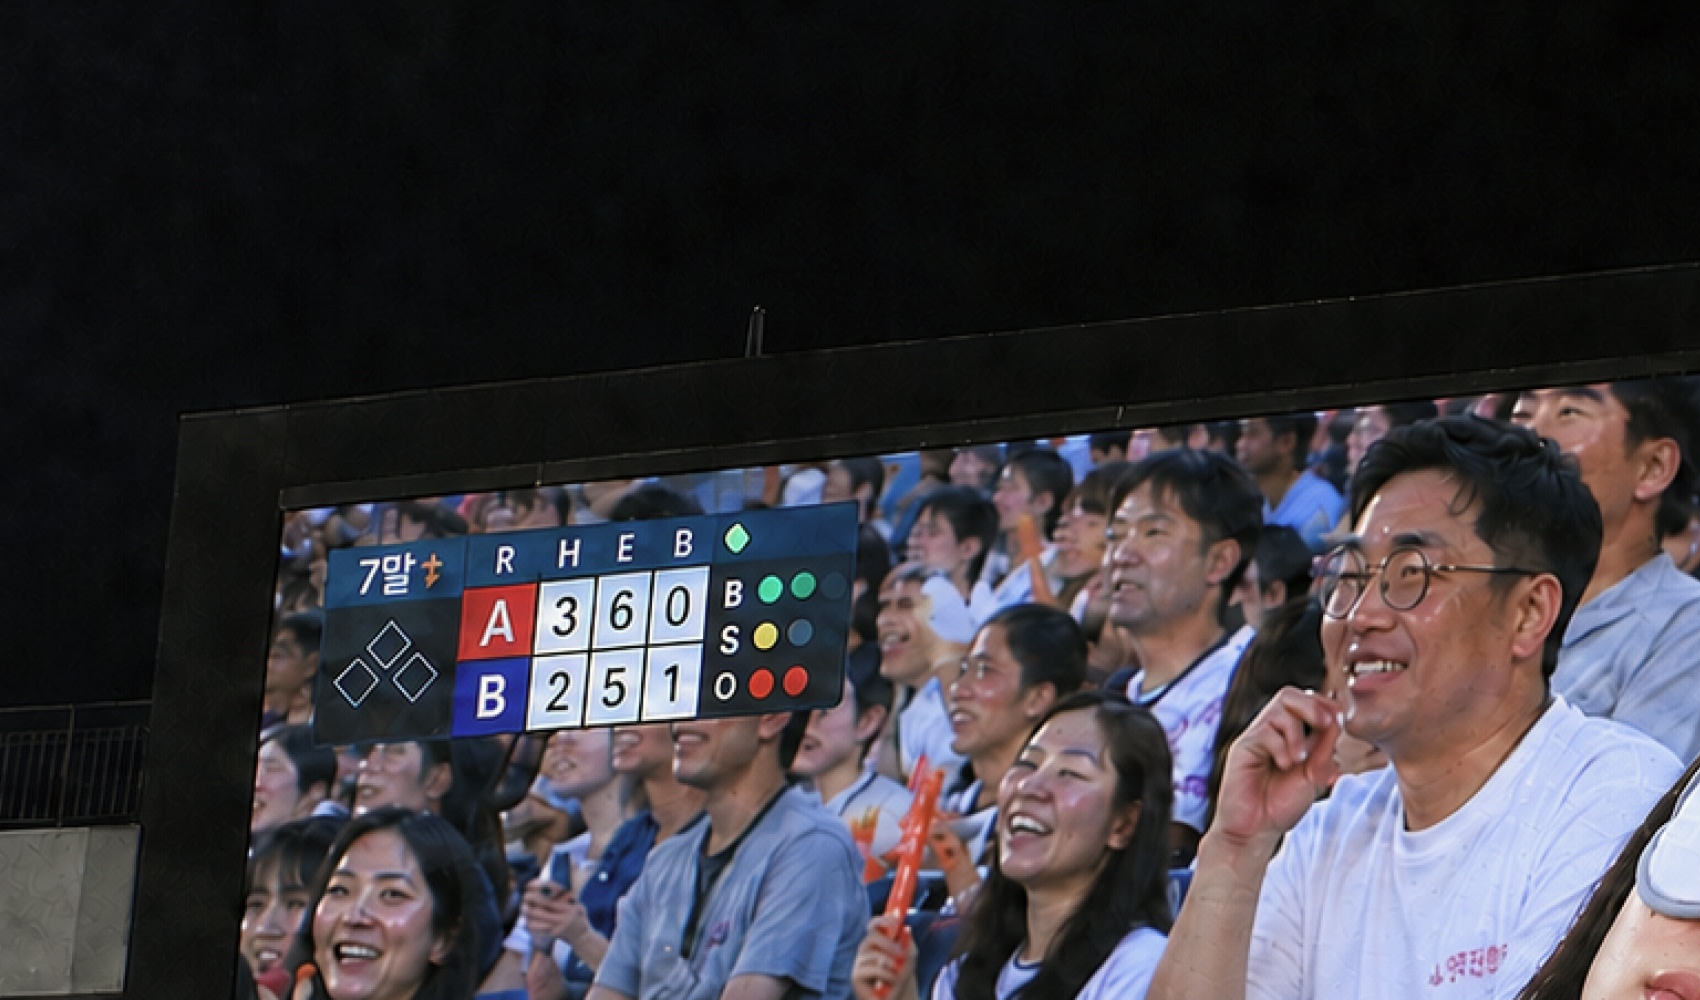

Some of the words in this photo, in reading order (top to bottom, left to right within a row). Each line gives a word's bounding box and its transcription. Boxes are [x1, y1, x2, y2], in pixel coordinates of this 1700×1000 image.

[496, 545, 515, 574] R
[558, 538, 581, 569] H
[618, 534, 635, 562] E
[673, 529, 693, 558] B
[359, 552, 416, 596] 7말
[724, 580, 744, 609] B
[479, 599, 515, 647] A
[552, 596, 578, 637] 3
[609, 589, 633, 631] 6
[665, 585, 691, 627] 0
[720, 625, 740, 655] S
[476, 674, 507, 718] B
[545, 671, 571, 713] 2
[602, 667, 626, 708] 5
[664, 664, 679, 702] 1
